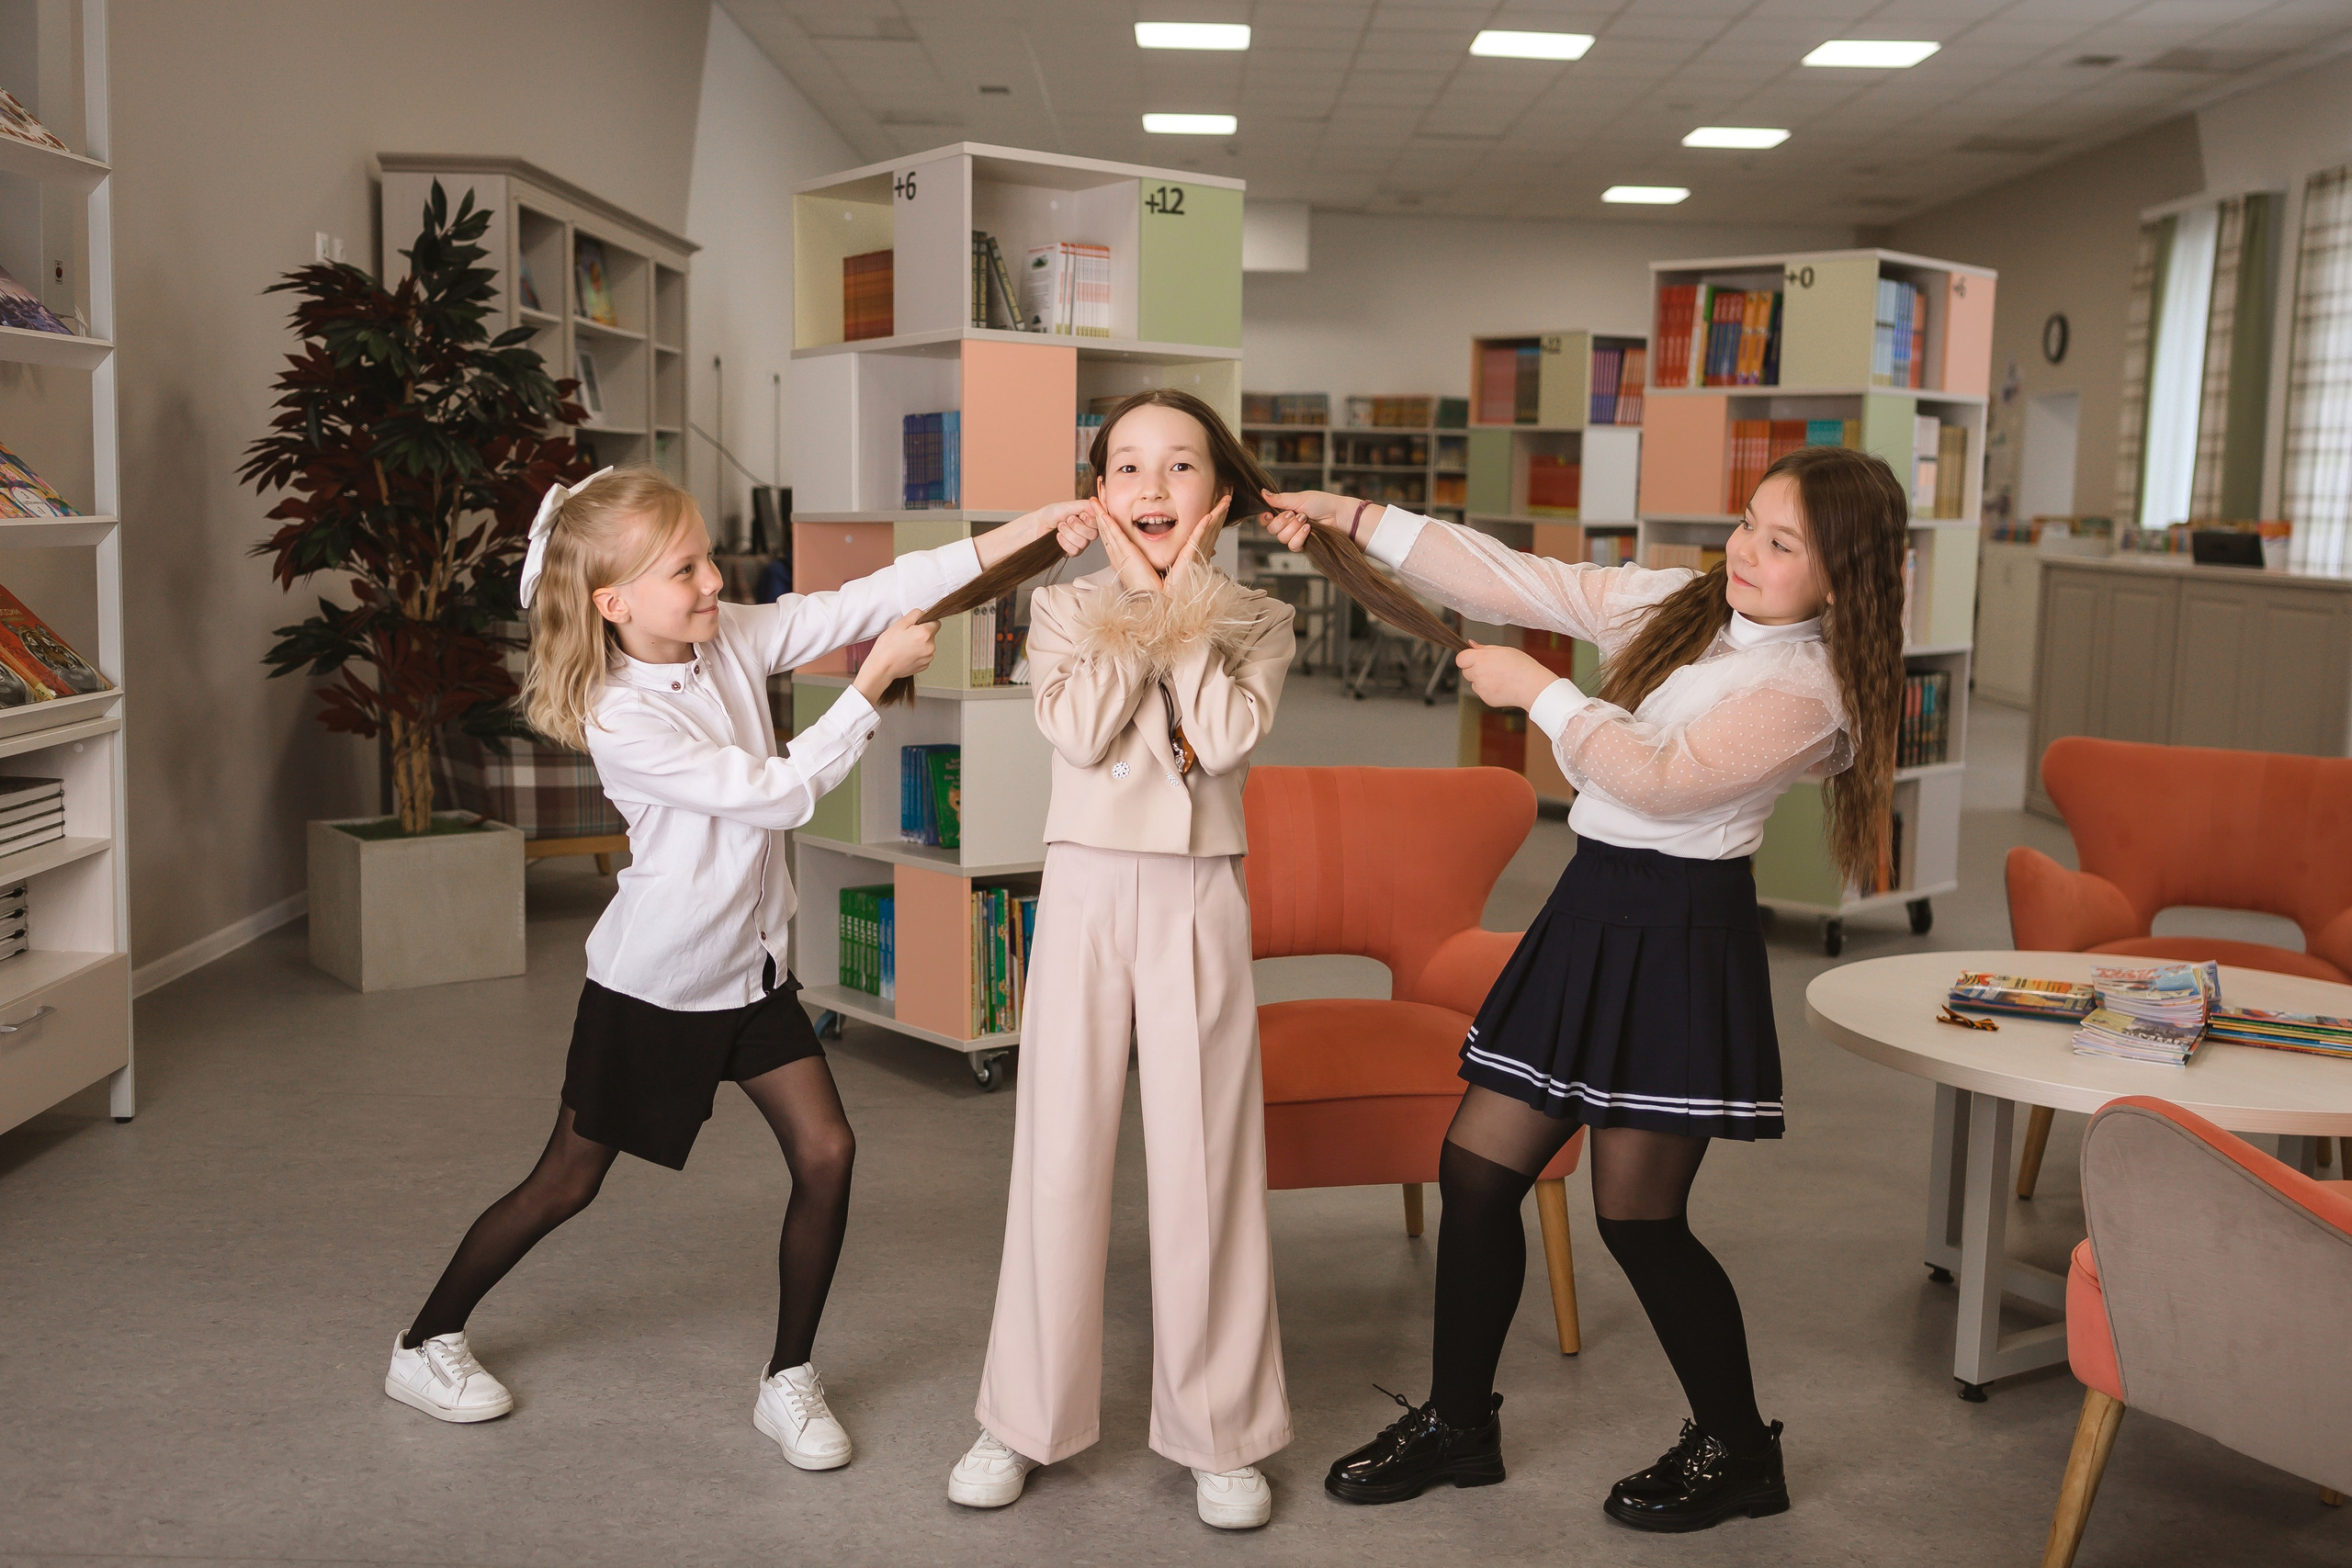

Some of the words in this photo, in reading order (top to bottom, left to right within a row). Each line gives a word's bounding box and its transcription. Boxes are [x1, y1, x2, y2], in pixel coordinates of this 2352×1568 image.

[894, 171, 917, 201] +6
[1145, 186, 1185, 216] +12
[1785, 266, 1815, 289] +0
